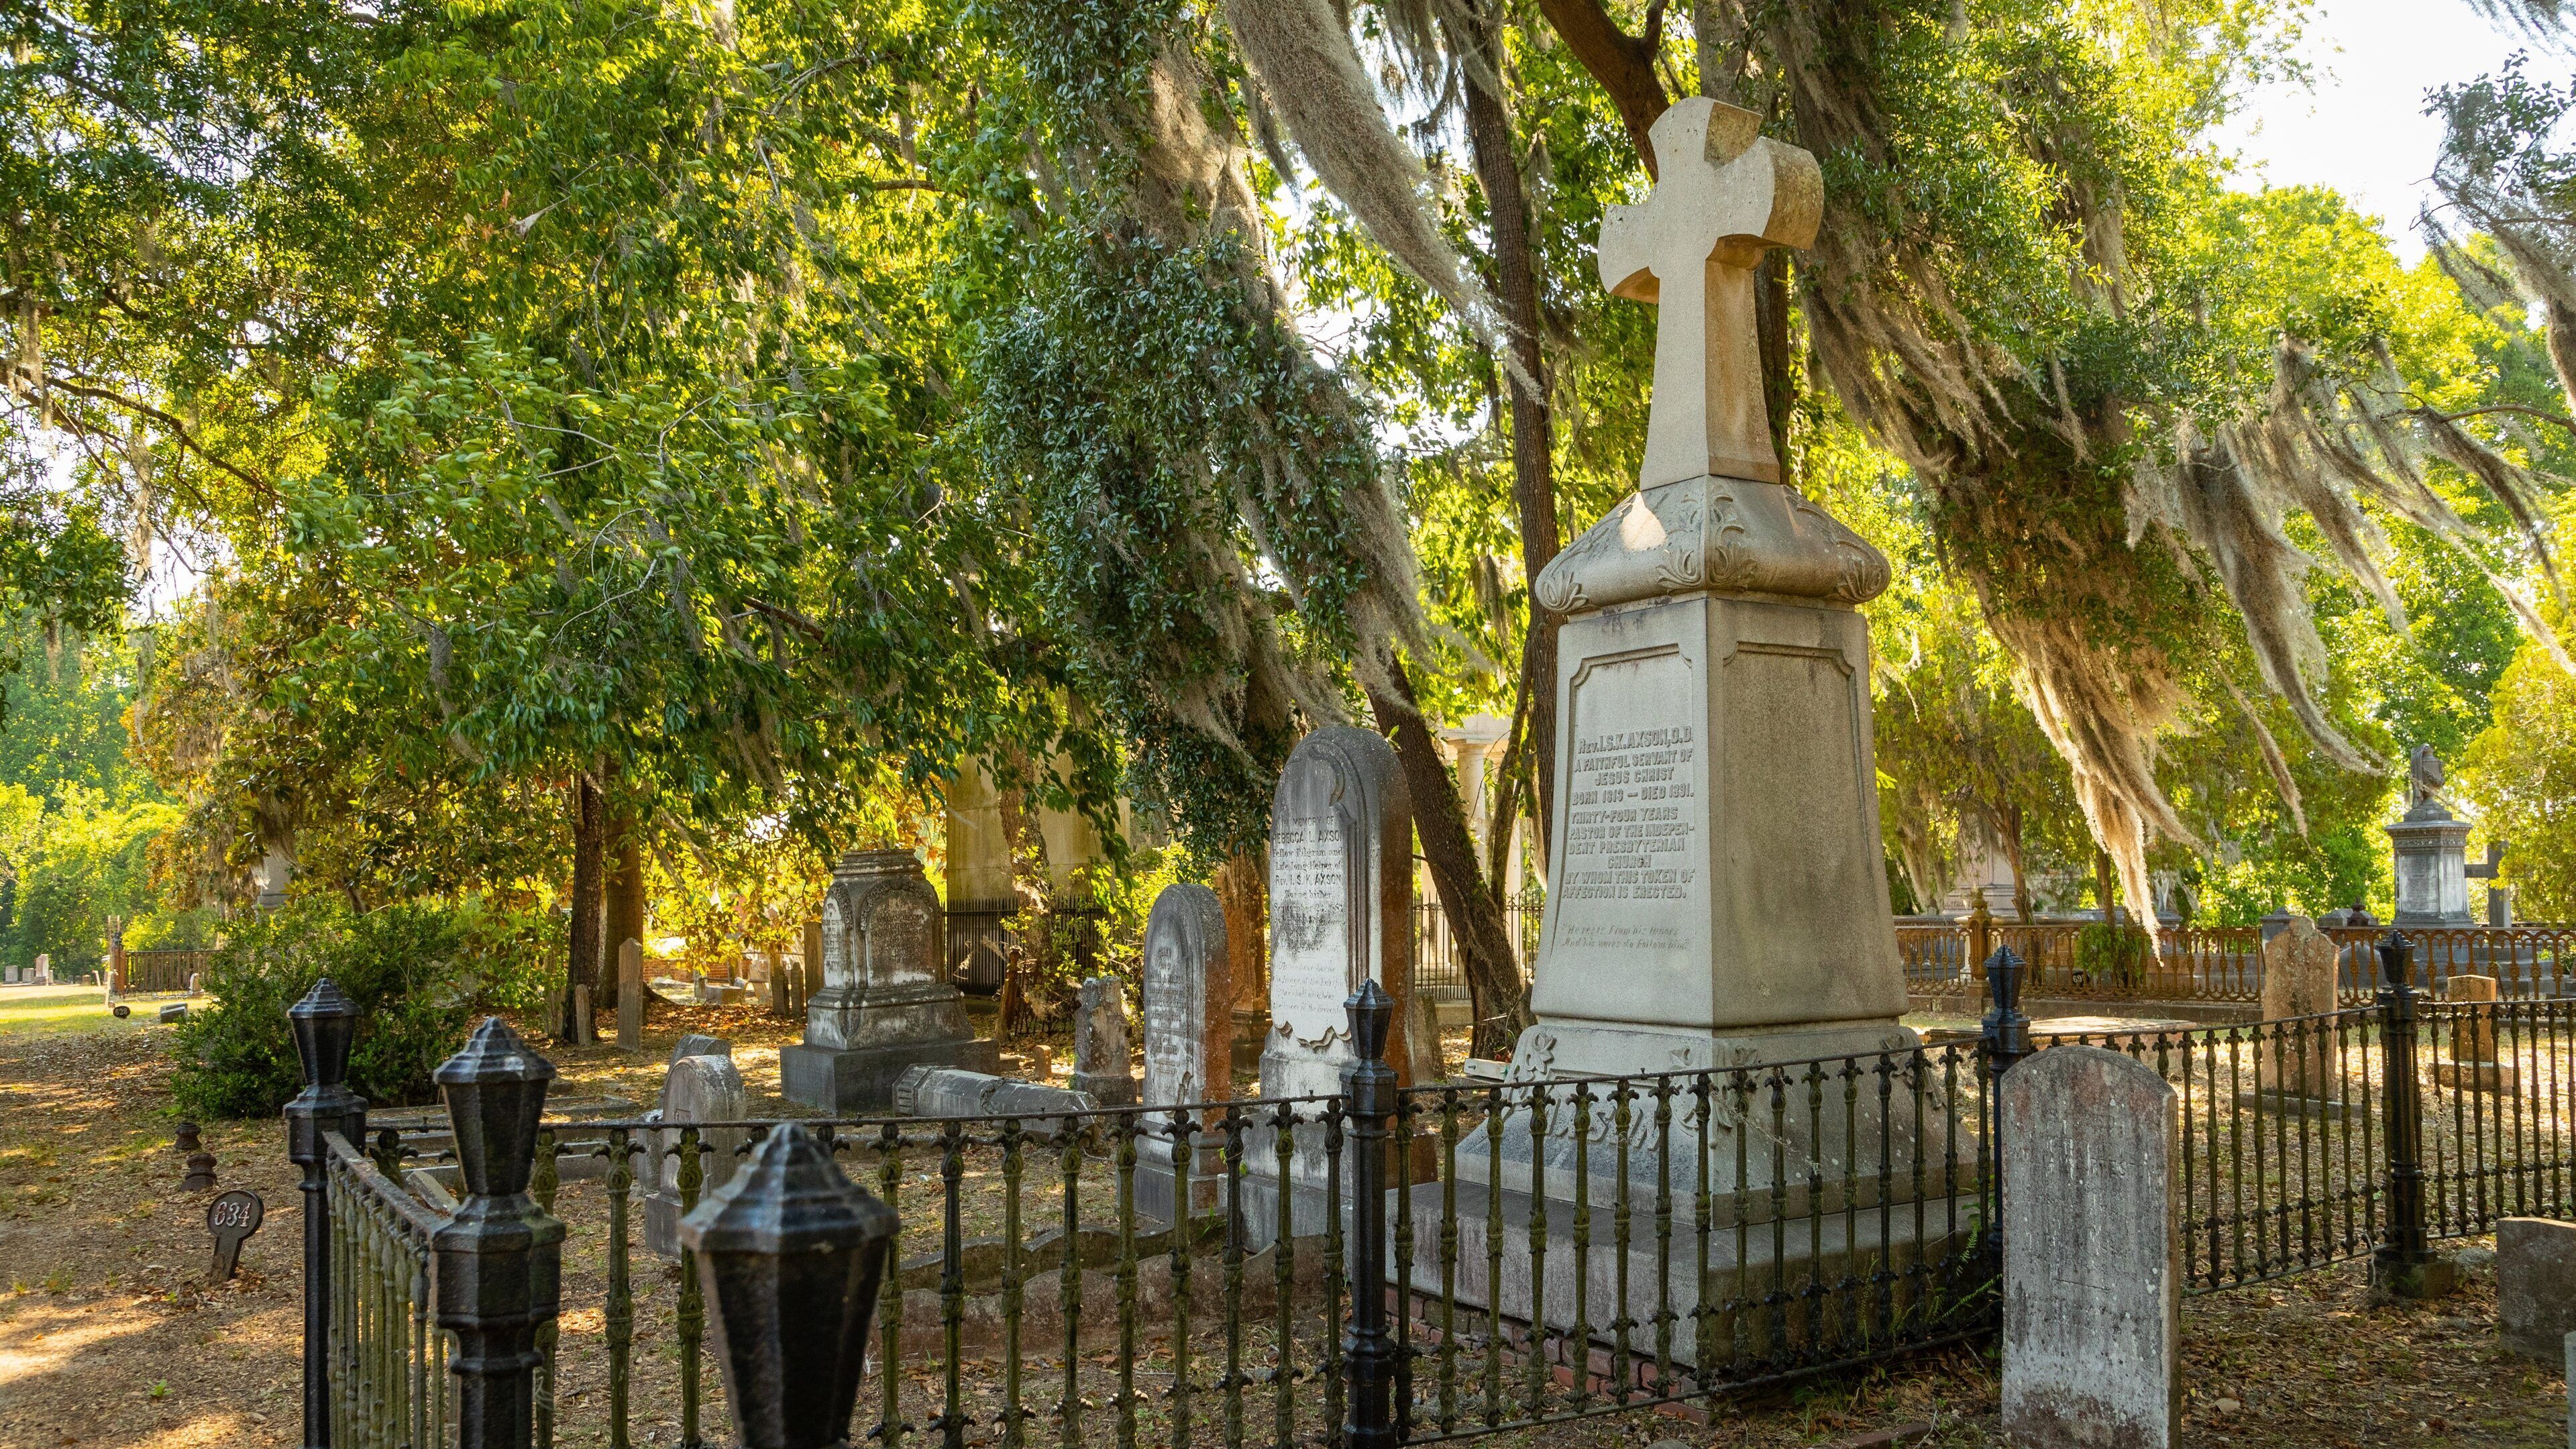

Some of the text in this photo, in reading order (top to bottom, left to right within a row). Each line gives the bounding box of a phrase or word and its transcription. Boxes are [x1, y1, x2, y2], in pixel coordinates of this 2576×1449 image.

[1574, 748, 1693, 772] A FAITHFUL SERVANT OF
[1595, 767, 1674, 786] JESUS CHRIST
[1572, 790, 1598, 805] BORN
[1641, 786, 1666, 800] DIED
[1570, 806, 1678, 824] THIRTY-FOUR YEARS
[1570, 822, 1695, 840] PASTOR OF THE INDEPEN-
[1568, 838, 1684, 855] DENT PRESBYTERIAN
[1607, 855, 1652, 869] CHURCH
[1564, 869, 1695, 884] BY WHOM THIS TOKEN OF
[1562, 885, 1687, 898] AFFECTION IS ERECTED.
[2073, 974, 2084, 983] 69
[115, 1008, 128, 1016] 628
[214, 1201, 251, 1227] 634
